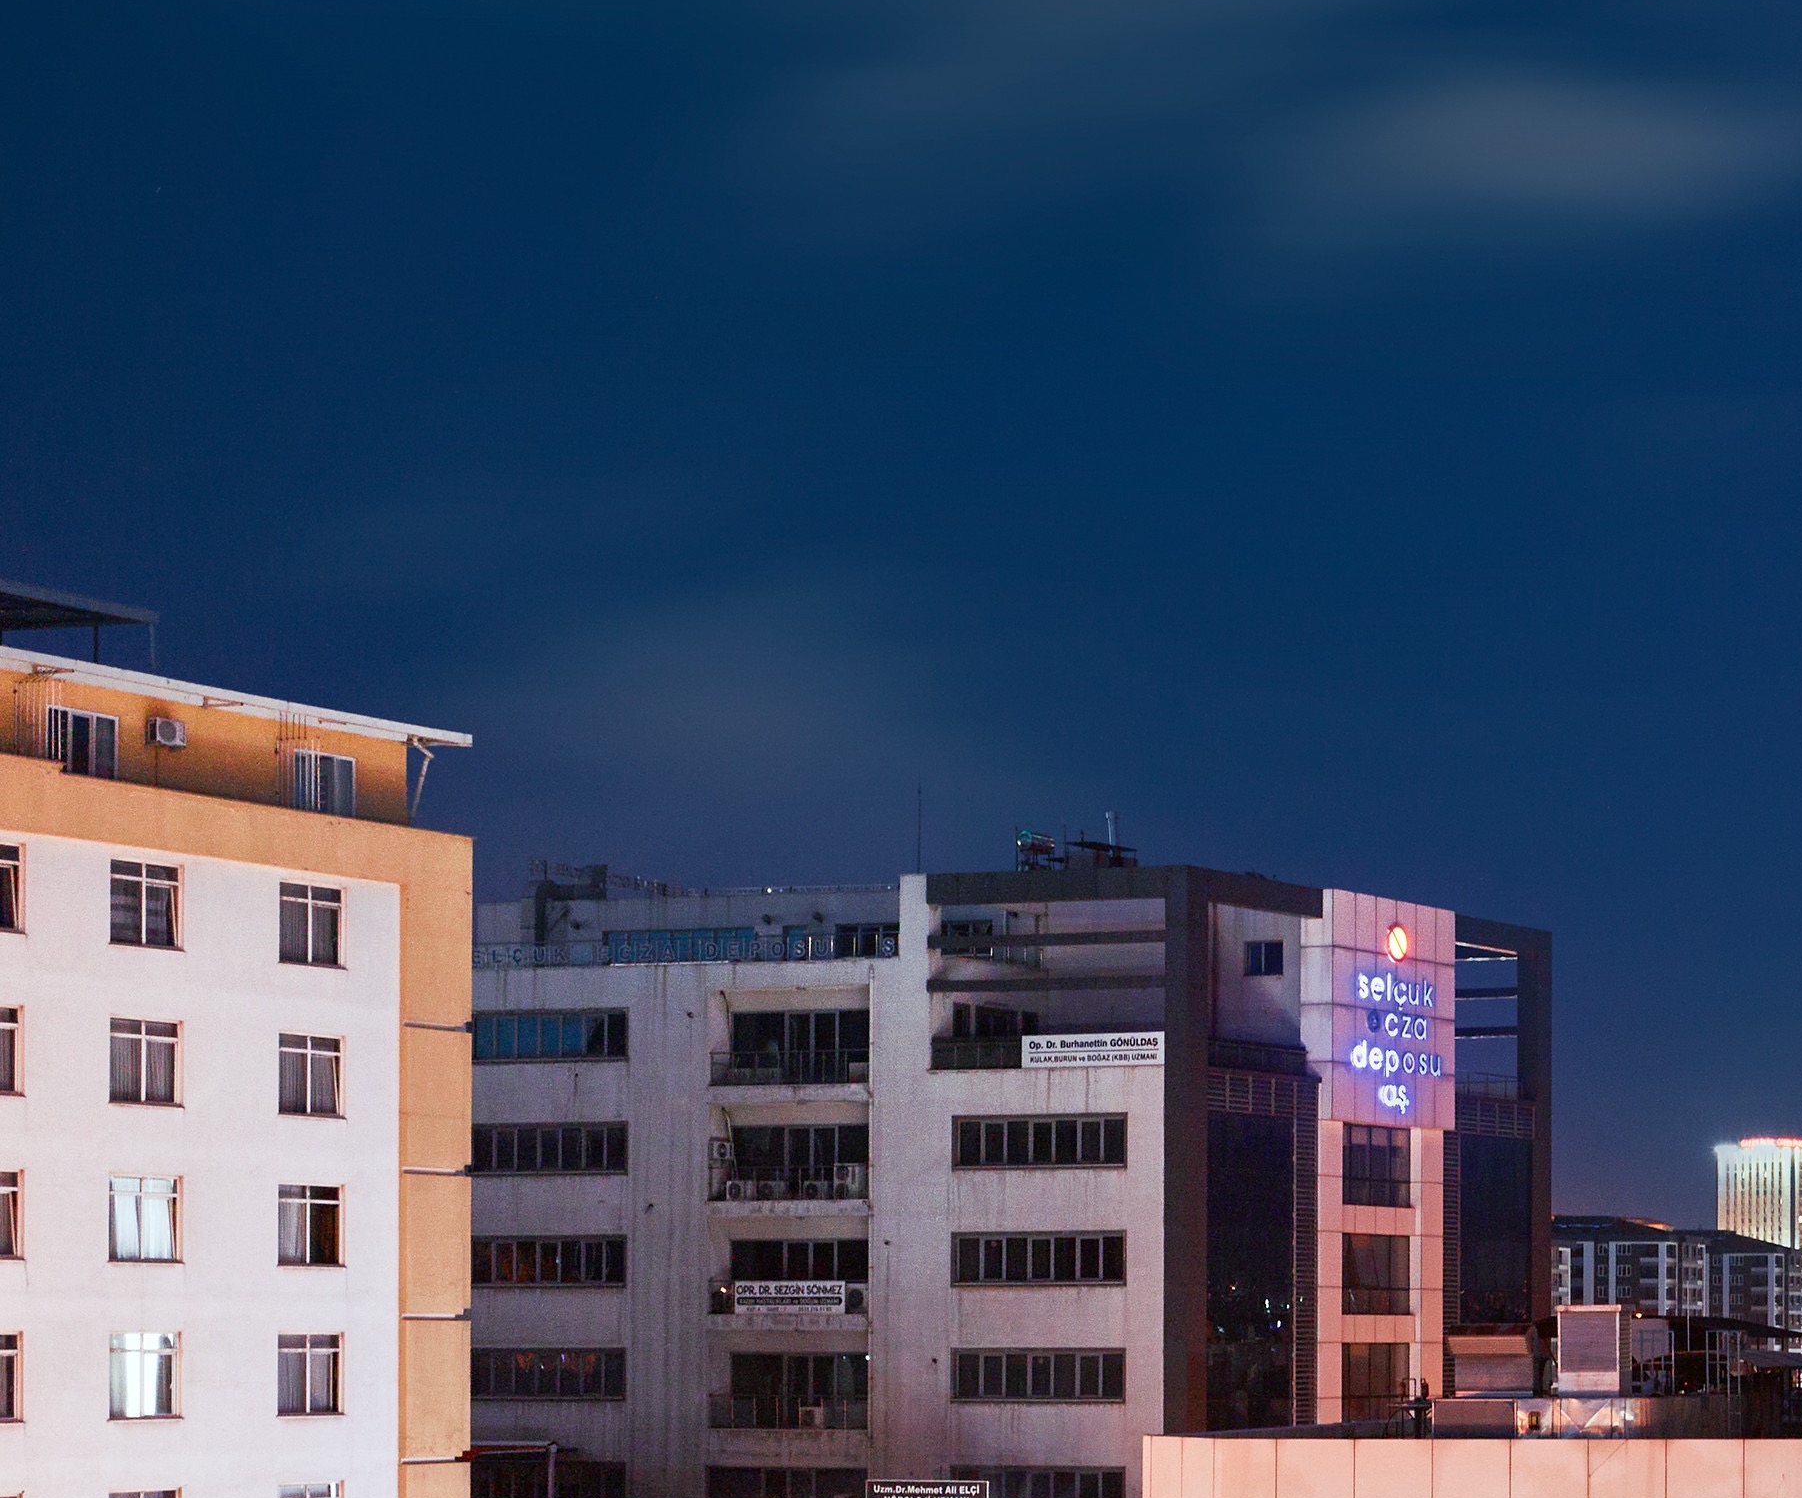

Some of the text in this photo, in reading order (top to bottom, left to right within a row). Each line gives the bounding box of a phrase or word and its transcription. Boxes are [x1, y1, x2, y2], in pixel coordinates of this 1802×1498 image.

[705, 938, 829, 959] DEPOSU
[1358, 973, 1434, 1010] selçuk
[1029, 1037, 1158, 1050] Op. Dr. Burhanettin GÖNÜLDAŞ
[1132, 1053, 1157, 1061] UZMANI
[1351, 1039, 1441, 1078] deposu
[736, 1283, 842, 1295] OPR. DR. SEZGİN SÖNMEZ
[945, 1485, 957, 1494] Ali
[959, 1484, 980, 1496] ELÇİ
